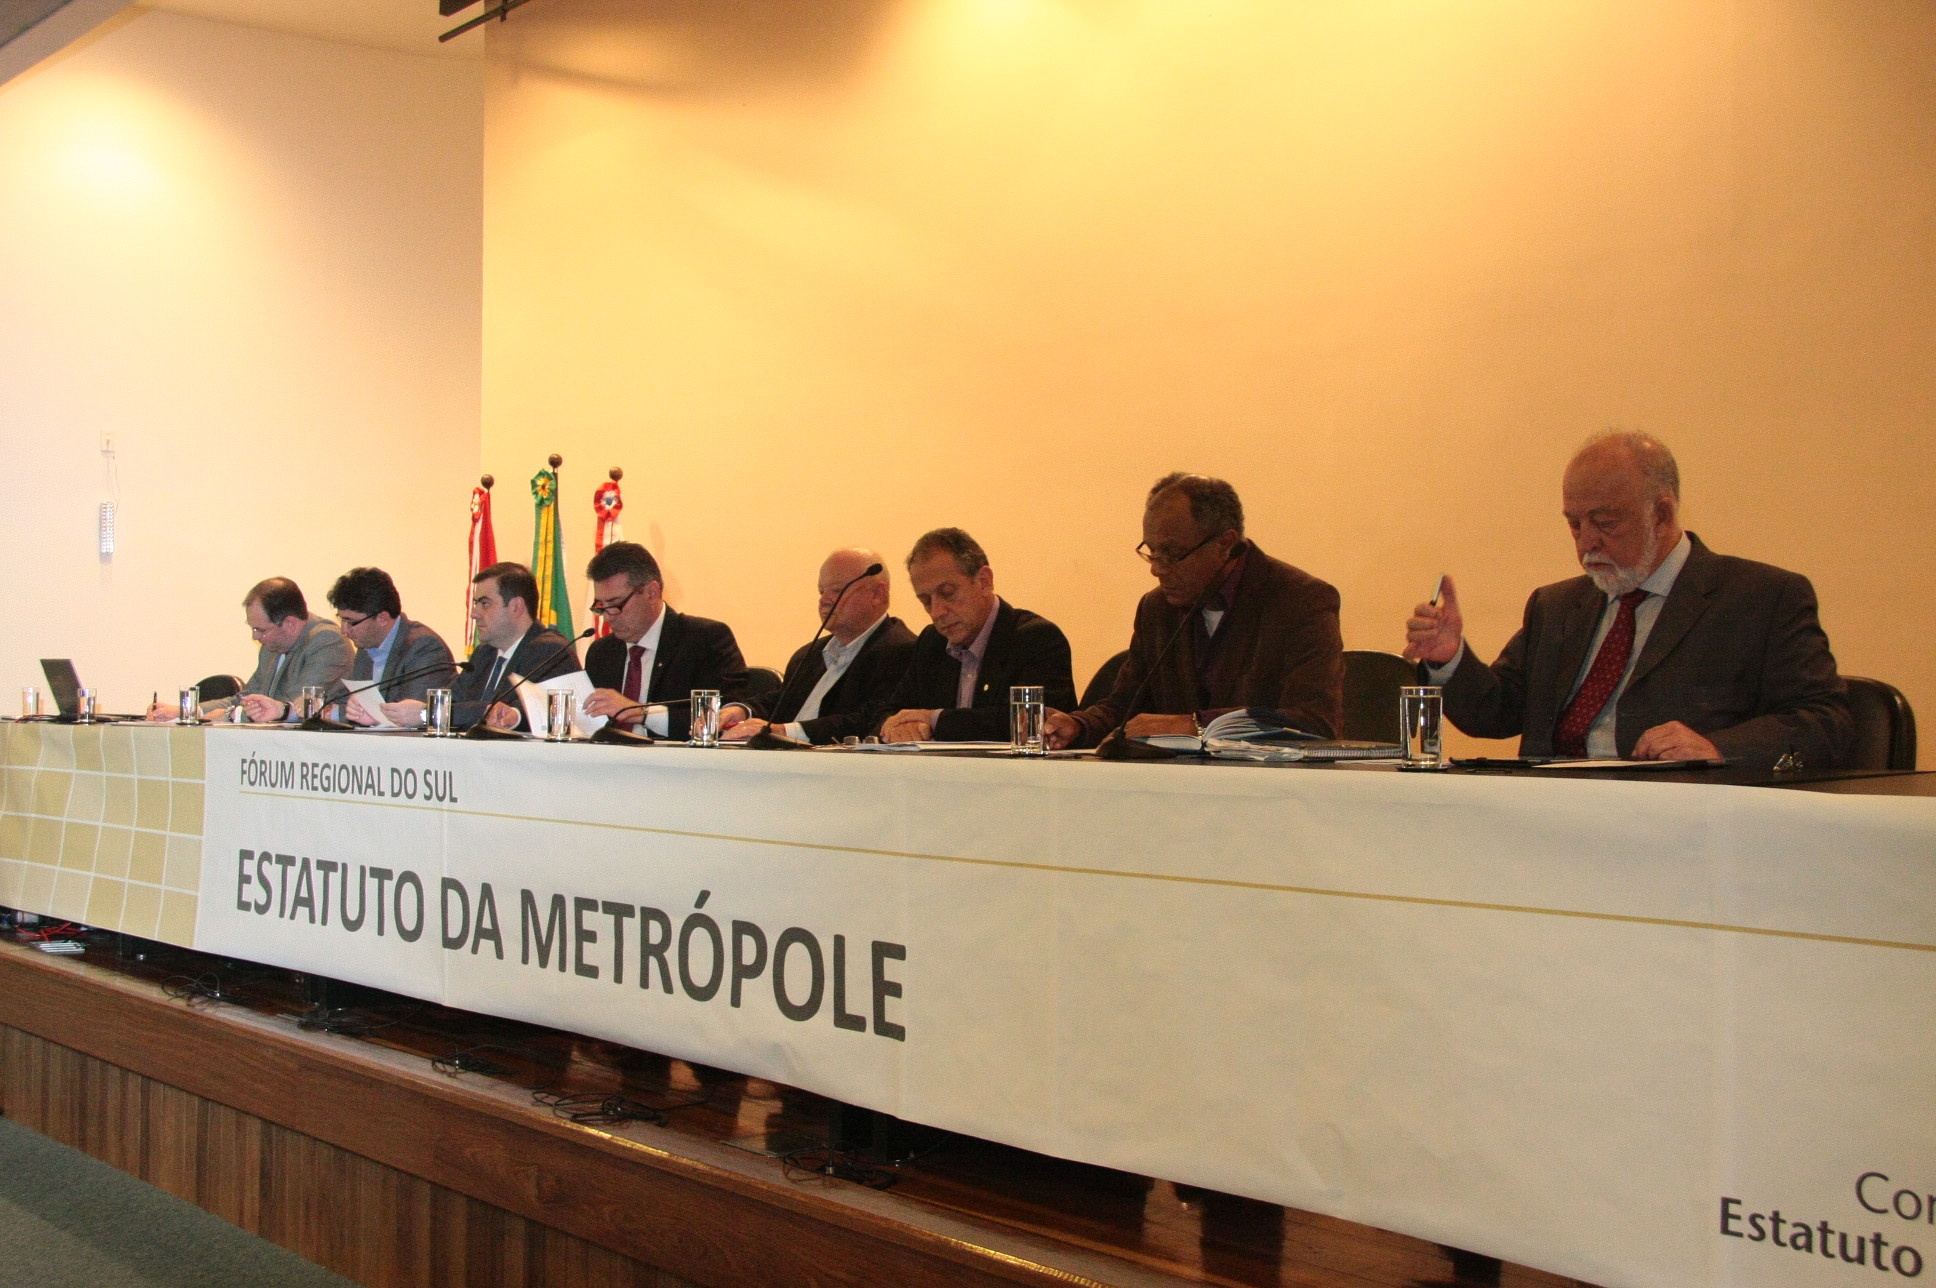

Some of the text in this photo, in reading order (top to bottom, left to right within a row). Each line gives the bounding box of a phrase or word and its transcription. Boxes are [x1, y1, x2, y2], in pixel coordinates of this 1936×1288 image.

[240, 751, 458, 803] FÓRUM REGIONAL DO SUL
[236, 848, 907, 1042] ESTATUTO DA METRÓPOLE
[1719, 1196, 1923, 1277] Estatuto
